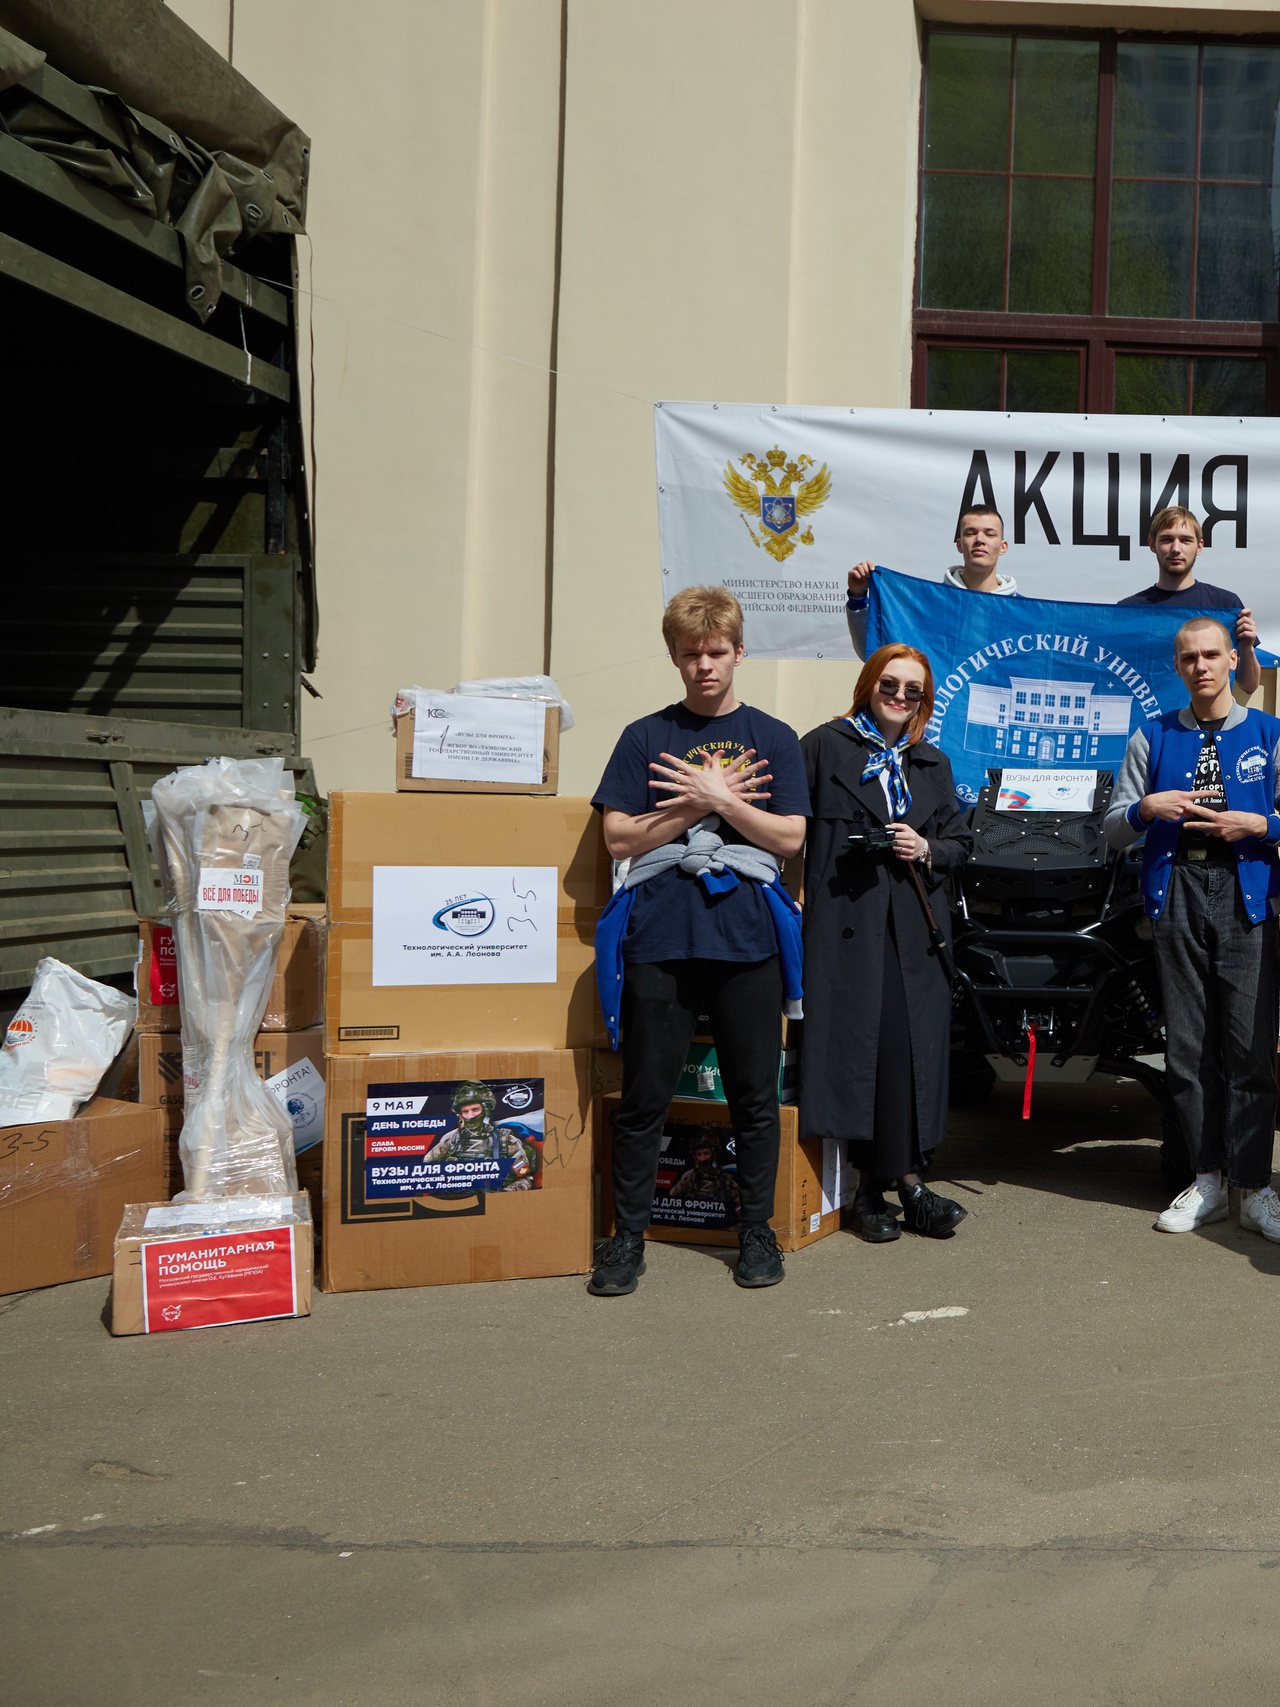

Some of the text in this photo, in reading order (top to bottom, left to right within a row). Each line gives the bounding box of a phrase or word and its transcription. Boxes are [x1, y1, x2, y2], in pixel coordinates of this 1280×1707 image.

[955, 450, 1249, 561] АКЦИЯ
[722, 580, 839, 590] МИНИСТЕРСТВО НАУКИ
[732, 591, 846, 601] ЫСШЕГО ОБРАЗОВАНИЯ
[740, 603, 846, 613] СИЙСКОЙ ФЕДЕРАЦИИ
[924, 634, 1090, 749] ХНОЛОГИЧЕСКИЙ
[1006, 774, 1092, 783] ВУЗЫ ДЛЯ ФРОНТА!
[203, 885, 259, 904] ВСЁ ДЛЯ ПОБЕДЫ
[454, 894, 467, 902] ЛЕТ
[403, 943, 474, 951] Технологический
[373, 1101, 414, 1111] 9 МАЯ
[372, 1119, 446, 1131] ДЕНЬ ПОБЕДЫ
[372, 1162, 500, 1177] ВУЗЫ ДЛЯ ФРОНТА
[372, 1172, 499, 1185] Технологический университет
[436, 1181, 472, 1189] Леонова
[661, 1198, 725, 1211] ДЛЯ ФРОНТА
[686, 1210, 725, 1218] университет
[159, 1241, 275, 1265] ГУМАНИТАРНАЯ
[159, 1258, 227, 1276] ПОМОЩЬ
